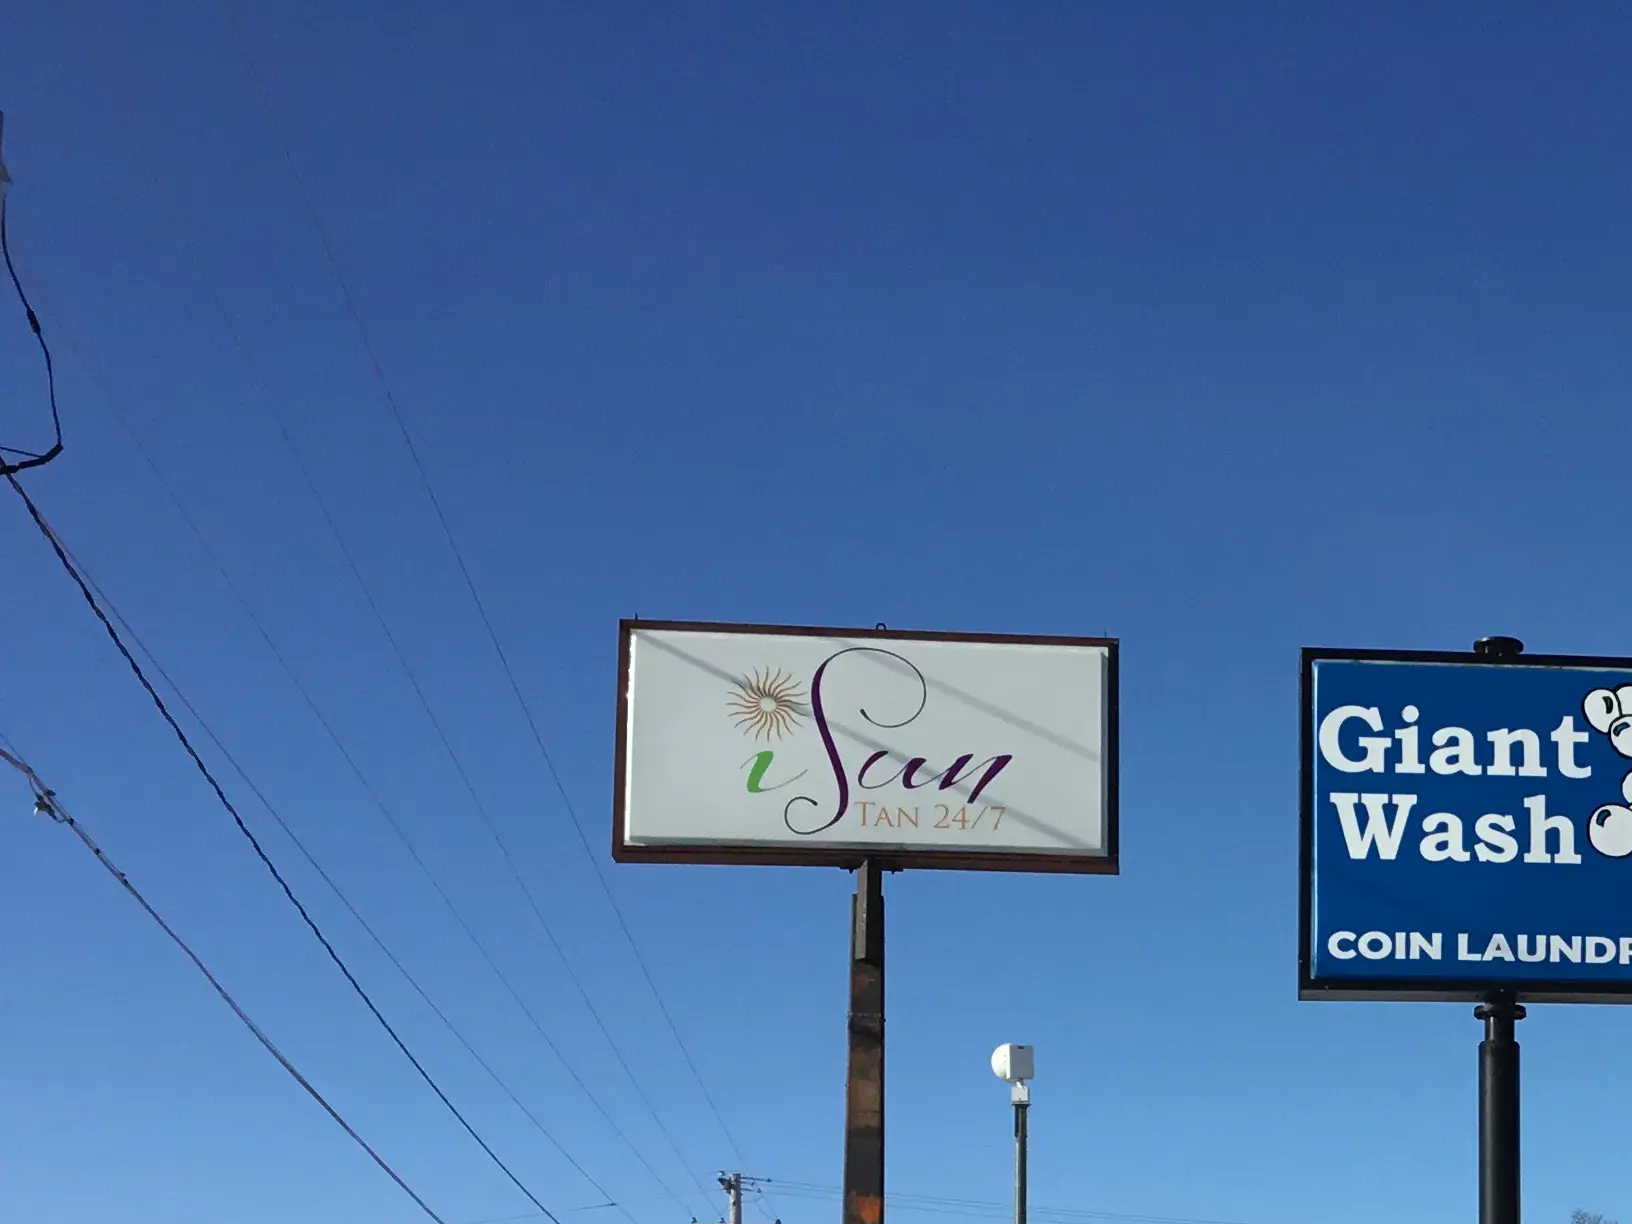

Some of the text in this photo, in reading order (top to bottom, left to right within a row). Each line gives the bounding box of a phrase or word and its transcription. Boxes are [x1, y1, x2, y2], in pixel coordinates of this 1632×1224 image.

[1318, 704, 1592, 779] Giant
[934, 804, 1006, 831] 24/7
[1329, 792, 1582, 865] Wash
[1327, 930, 1442, 960] COIN
